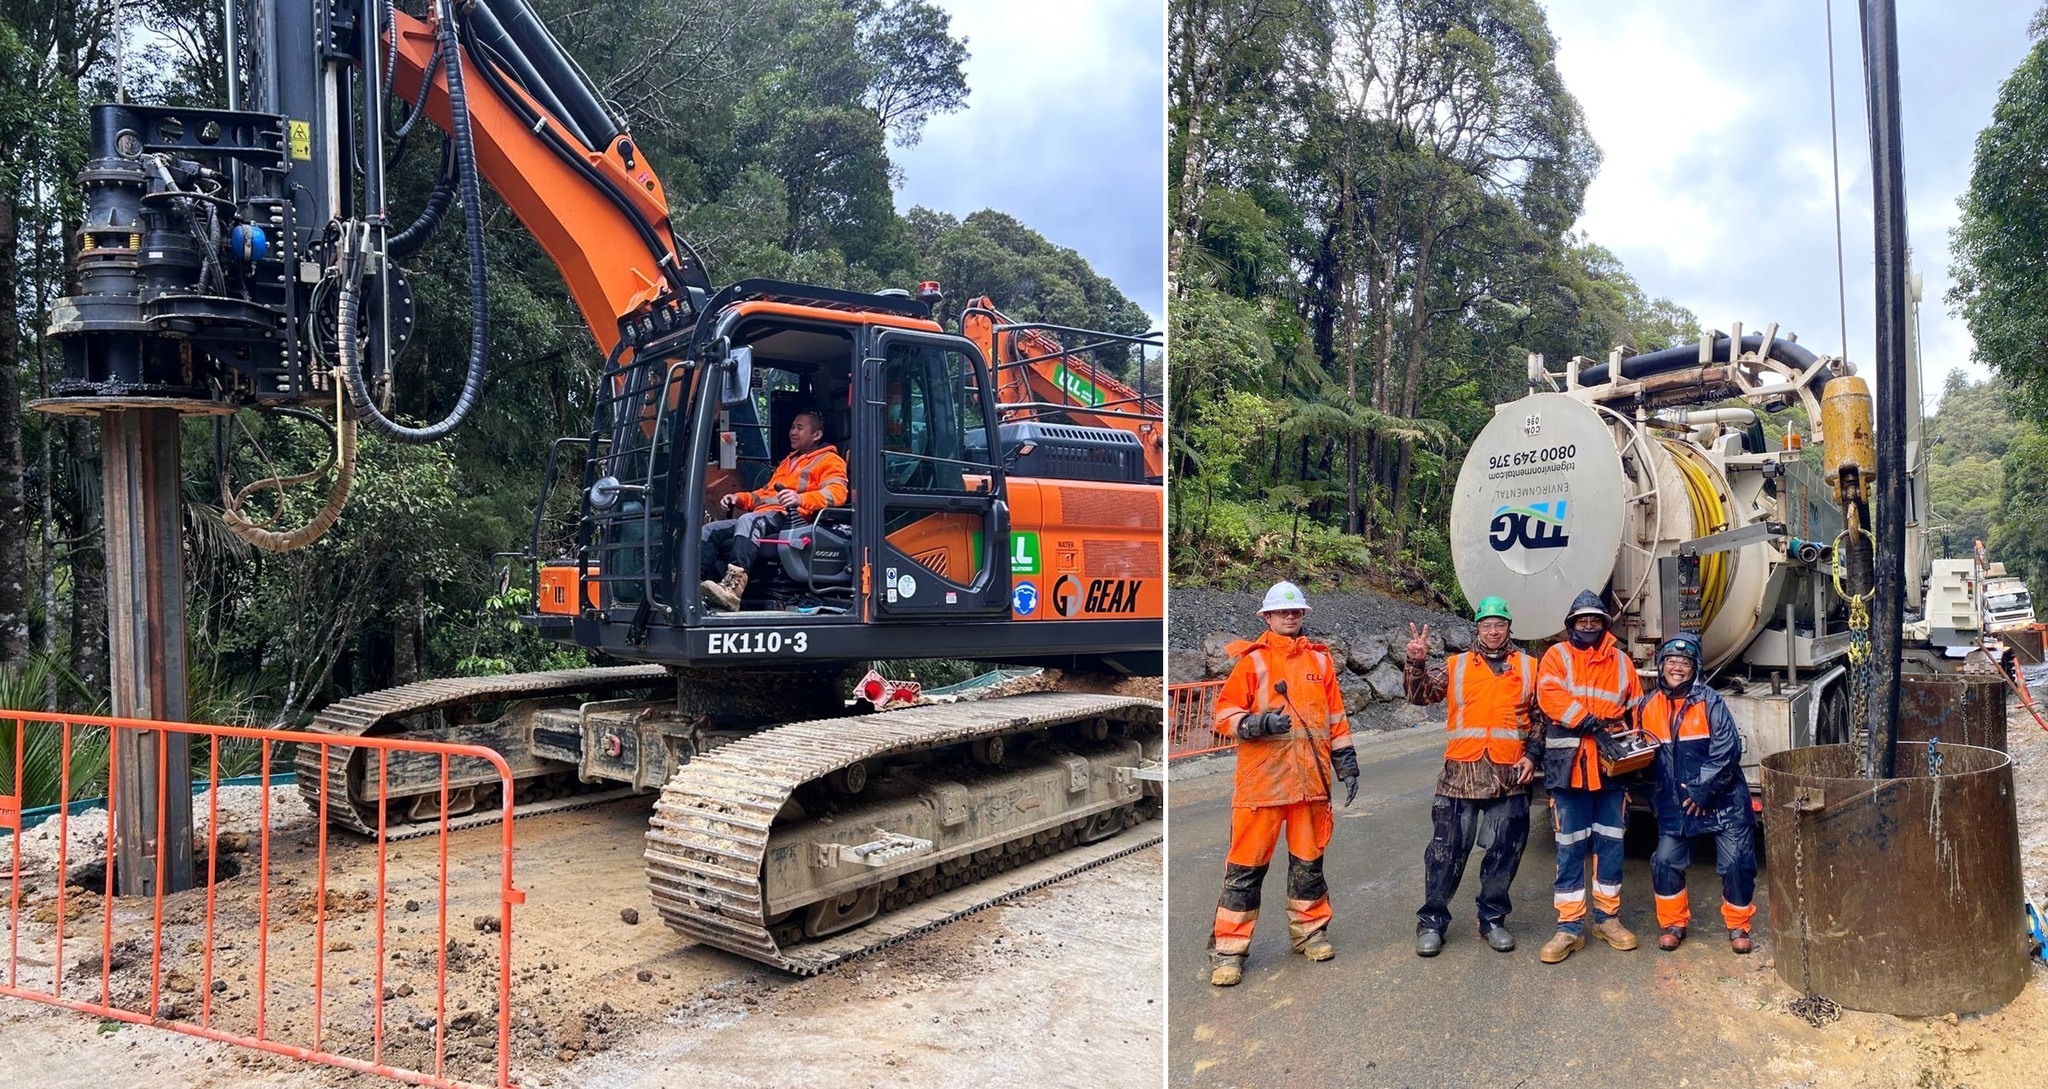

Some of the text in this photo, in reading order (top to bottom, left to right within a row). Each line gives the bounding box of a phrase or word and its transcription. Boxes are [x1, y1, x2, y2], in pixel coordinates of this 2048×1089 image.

[1489, 444, 1576, 470] 0800 249 376
[1488, 461, 1576, 480] tdgenvironmental.com
[1496, 483, 1569, 499] ENVIRONMENTAL
[1489, 500, 1570, 552] TDG
[1084, 579, 1142, 613] GEAX
[708, 631, 808, 654] EK110-3
[1306, 673, 1323, 682] CLL
